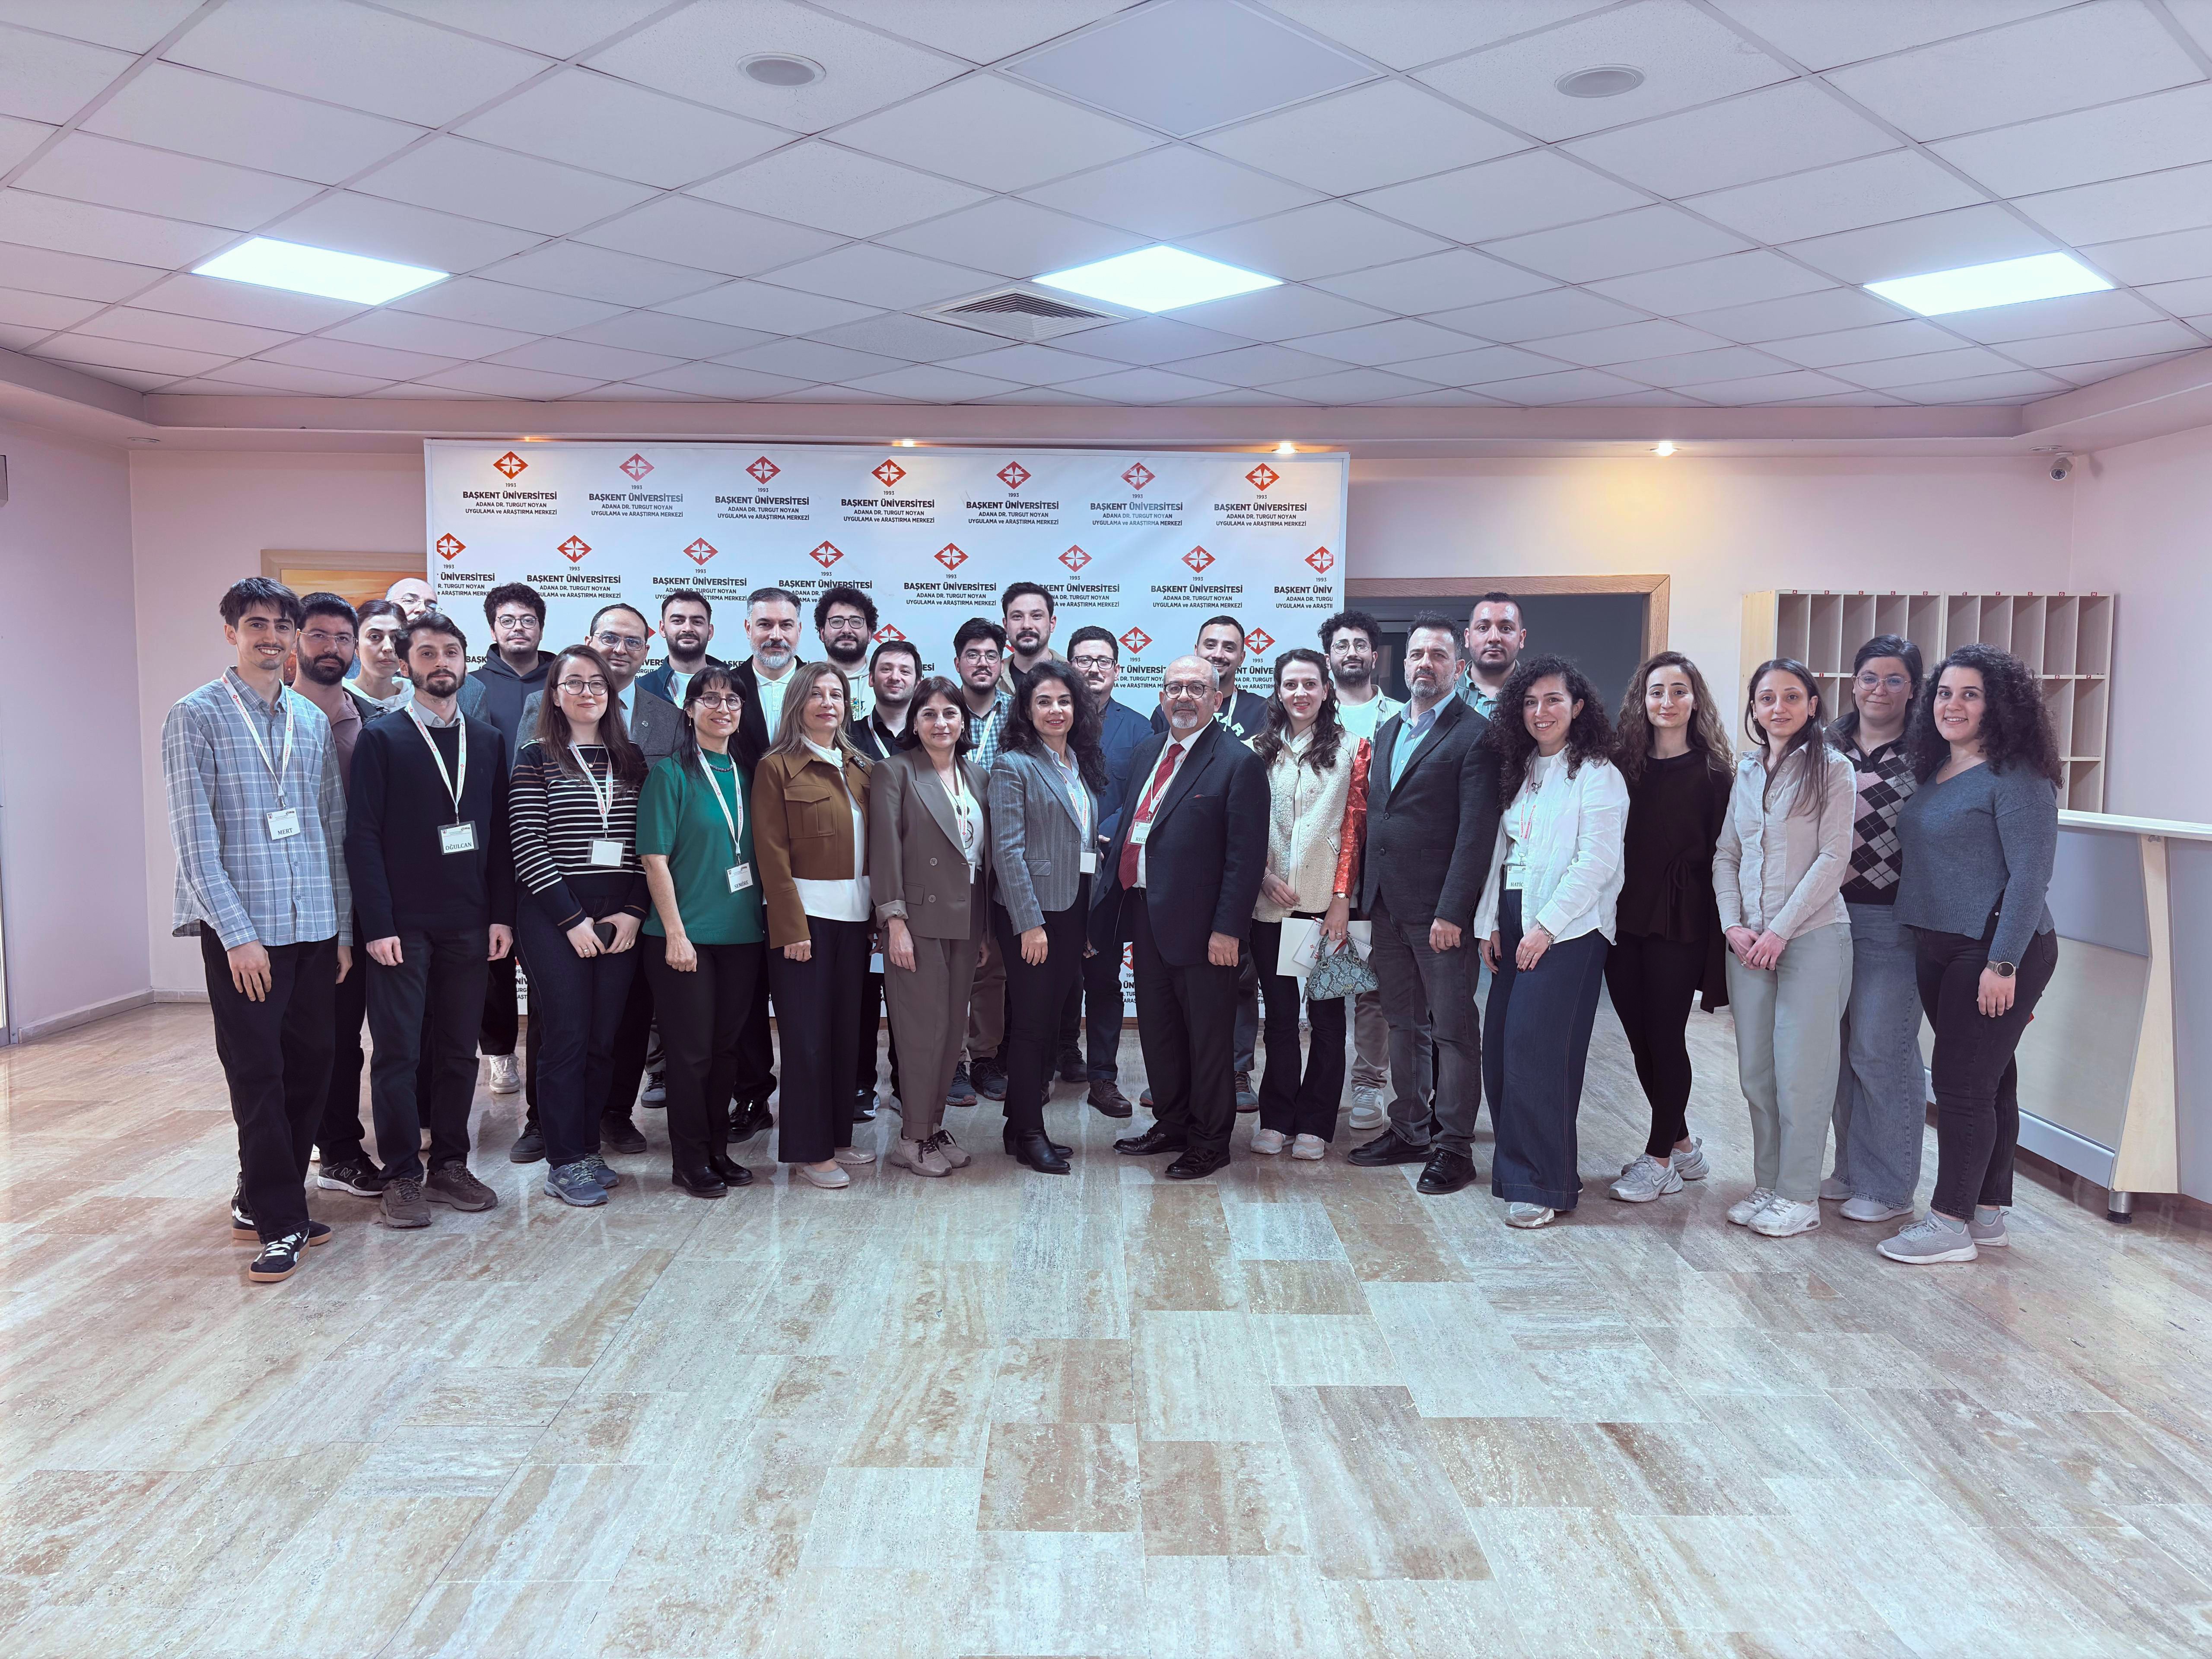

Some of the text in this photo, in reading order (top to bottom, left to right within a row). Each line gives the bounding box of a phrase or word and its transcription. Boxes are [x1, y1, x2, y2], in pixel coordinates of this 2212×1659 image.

[463, 490, 557, 500] BAŞKENT ÜNİVERSİTESİ
[589, 493, 683, 502] BAŞKENT ÜNİVERSİTESİ
[841, 499, 934, 509] BAŞKENT ÜNİVERSİTESİ
[966, 501, 1059, 510] BAŞKENT ÜNİVERSİTESİ
[1090, 502, 1183, 511] BAŞKENT ÜNİVERSİTESİ
[1214, 502, 1307, 512] BAŞKENT ÜNİVERSİTESİ
[441, 572, 495, 582] ÜNİVERSİTESİ
[527, 574, 620, 584] BAŞKENT ÜNİVERSİTESİ
[653, 577, 747, 587] BAŞKENT ÜNİVERSİTESİ
[779, 579, 872, 589] BAŞKENT ÜNİVERSİTESİ
[1067, 583, 1120, 592] ÜNİVERSİTESİ
[1151, 585, 1243, 594] BAŞKENT ÜNİVERSİTESİ
[1274, 586, 1310, 594] BAŞKENT
[466, 656, 487, 664] BAŞK
[734, 880, 749, 889] SEMİRE
